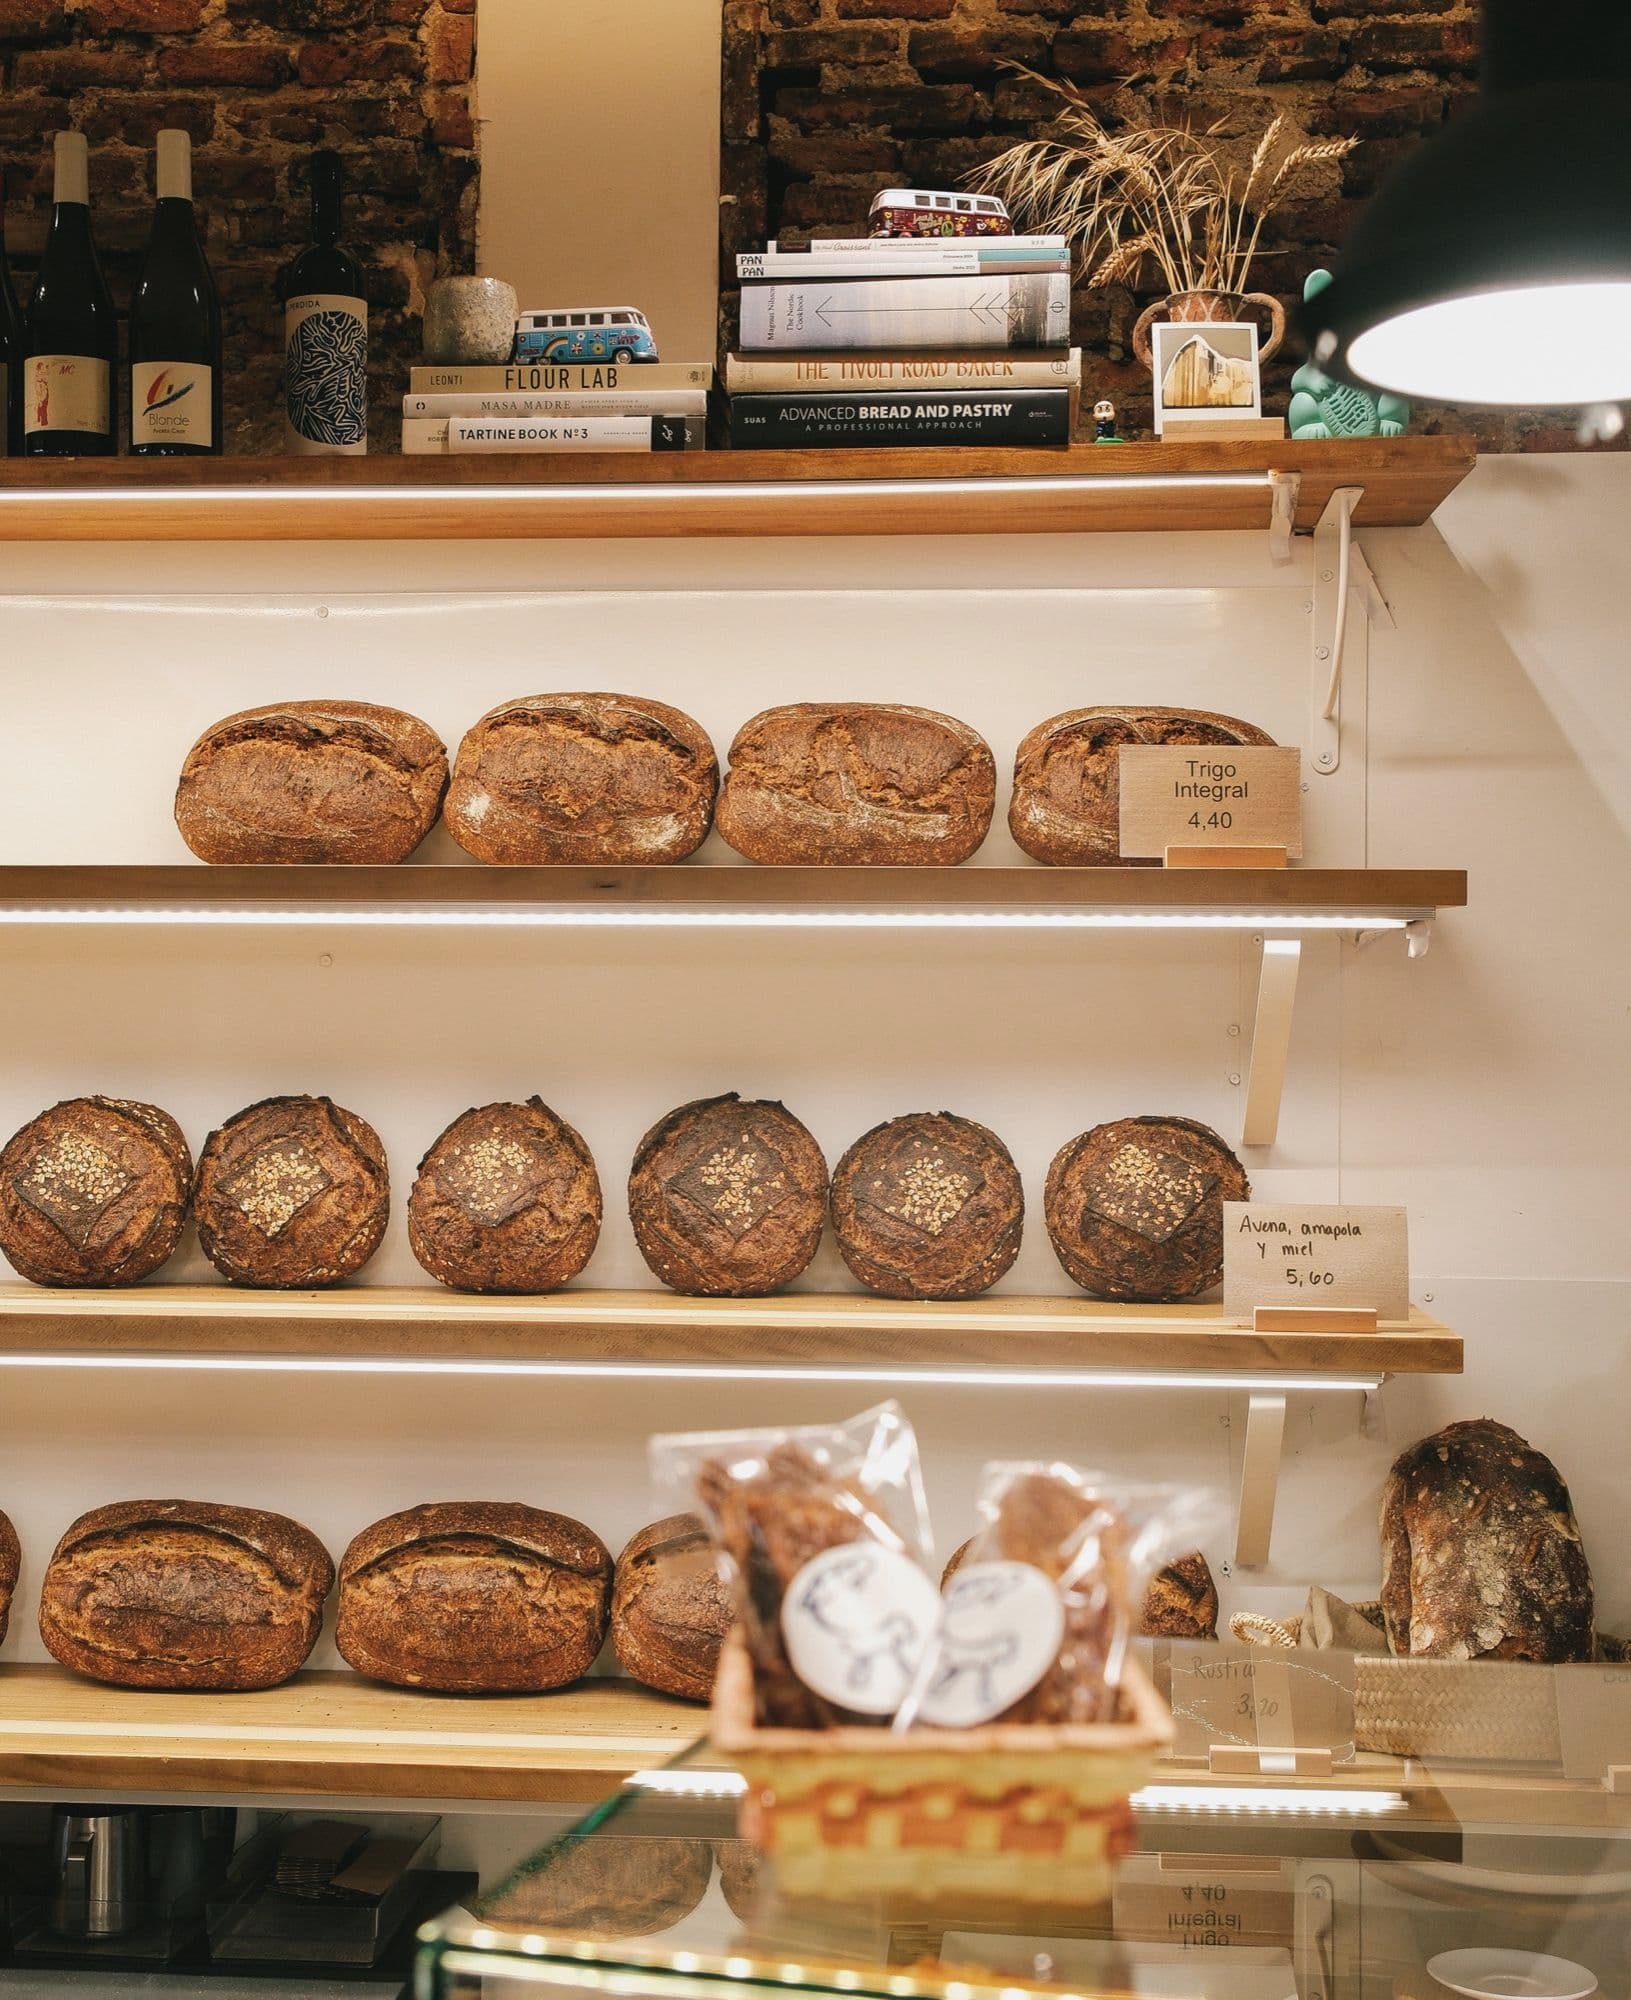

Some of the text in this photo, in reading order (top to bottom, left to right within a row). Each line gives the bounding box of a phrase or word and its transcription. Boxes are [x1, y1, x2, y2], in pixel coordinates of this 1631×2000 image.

[740, 255, 763, 265] PAN
[742, 267, 764, 276] PAN
[767, 286, 776, 341] Magnus Nilsson
[786, 294, 795, 332] The Nordic
[796, 295, 804, 330] Cookbook
[796, 360, 829, 380] THE
[902, 359, 948, 378] ROAD
[956, 358, 1014, 377] BAKER
[430, 375, 463, 386] LEONTI
[505, 367, 617, 390] FLOUR LAB
[481, 401, 518, 411] MASA
[523, 400, 571, 411] MADRE
[779, 404, 1013, 421] ADVANCED BREAD AND PASTRY
[149, 413, 190, 426] Blonde
[818, 423, 910, 431] PROFESSIONAL
[917, 421, 982, 429] APPROACH
[459, 429, 516, 440] TARTINE
[518, 429, 558, 440] BOOK
[1185, 760, 1237, 782] Trigo
[1175, 781, 1248, 802] Integral
[1188, 811, 1232, 831] 4,40
[1239, 1215, 1362, 1241] Avena, amapola
[1281, 1241, 1313, 1256] miel
